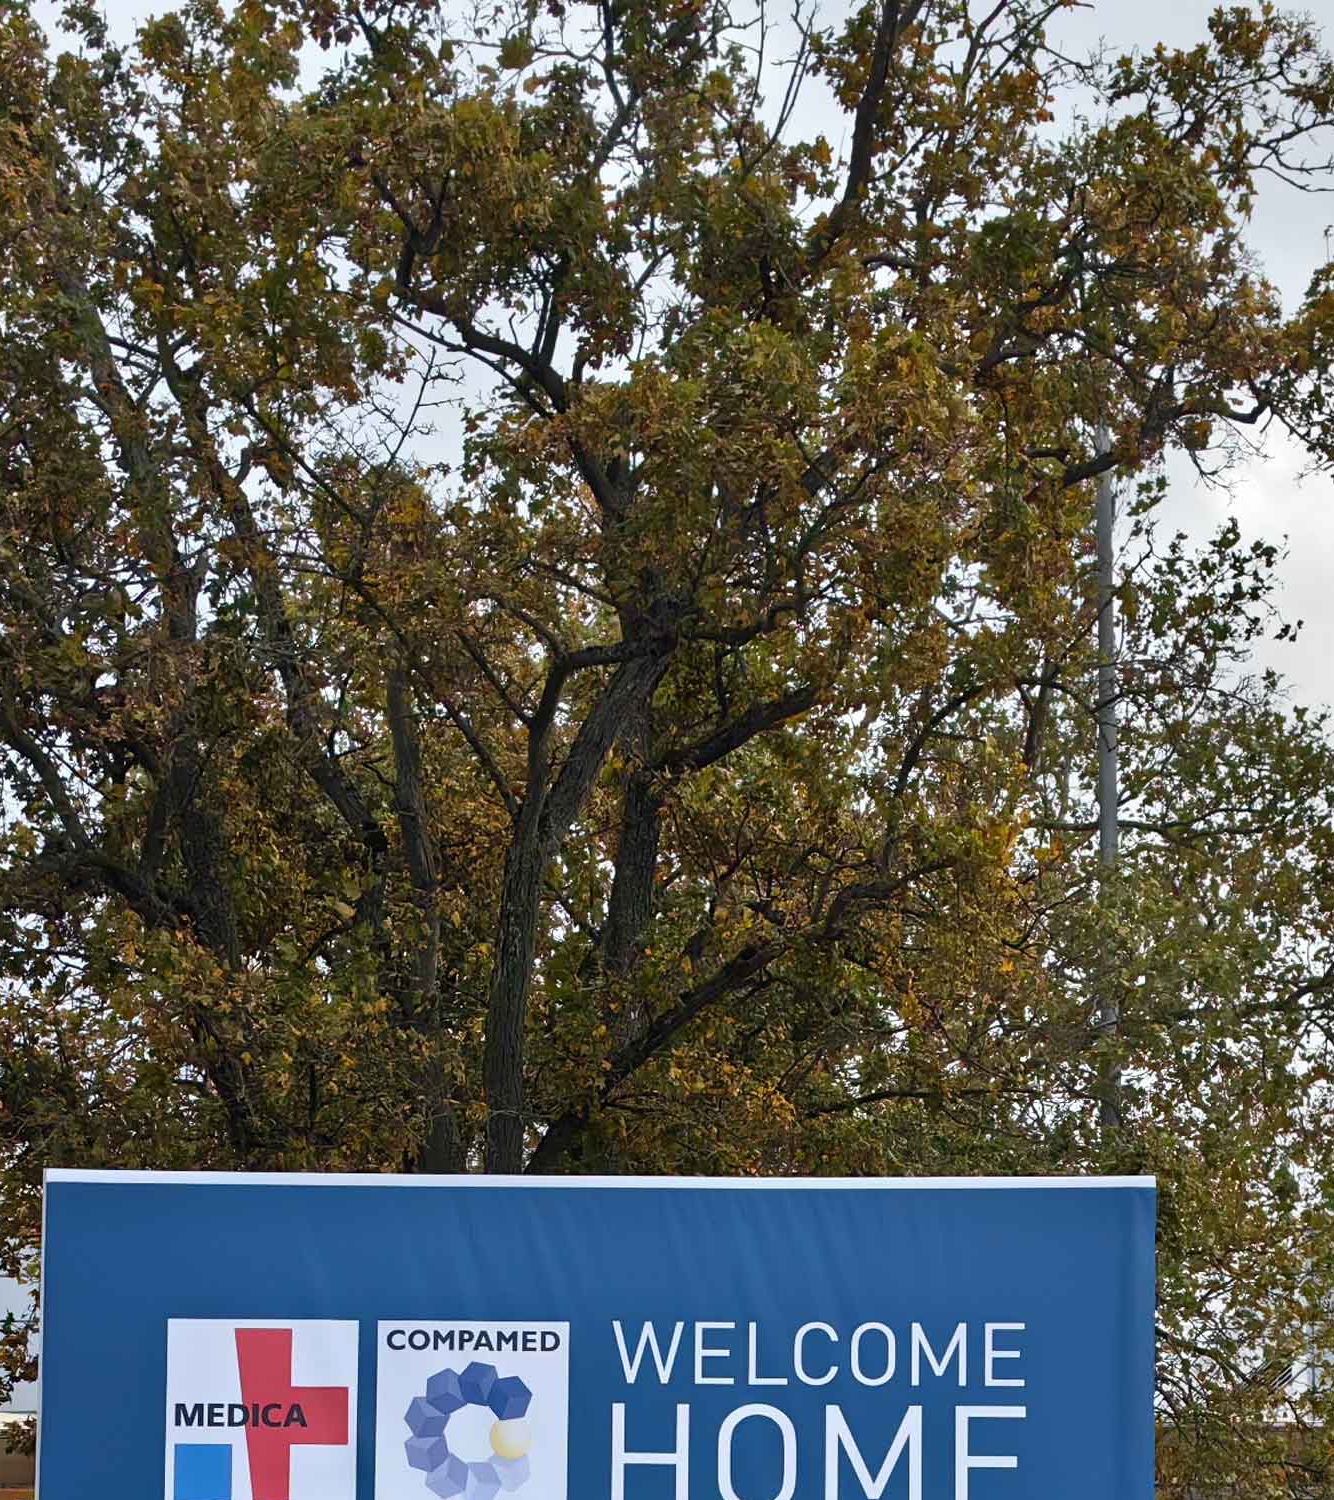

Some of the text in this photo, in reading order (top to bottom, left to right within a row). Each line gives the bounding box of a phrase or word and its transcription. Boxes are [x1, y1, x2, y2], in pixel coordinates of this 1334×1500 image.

[386, 1329, 561, 1353] COMPAMED
[612, 1320, 1027, 1387] WELCOME
[174, 1402, 308, 1428] MEDICA
